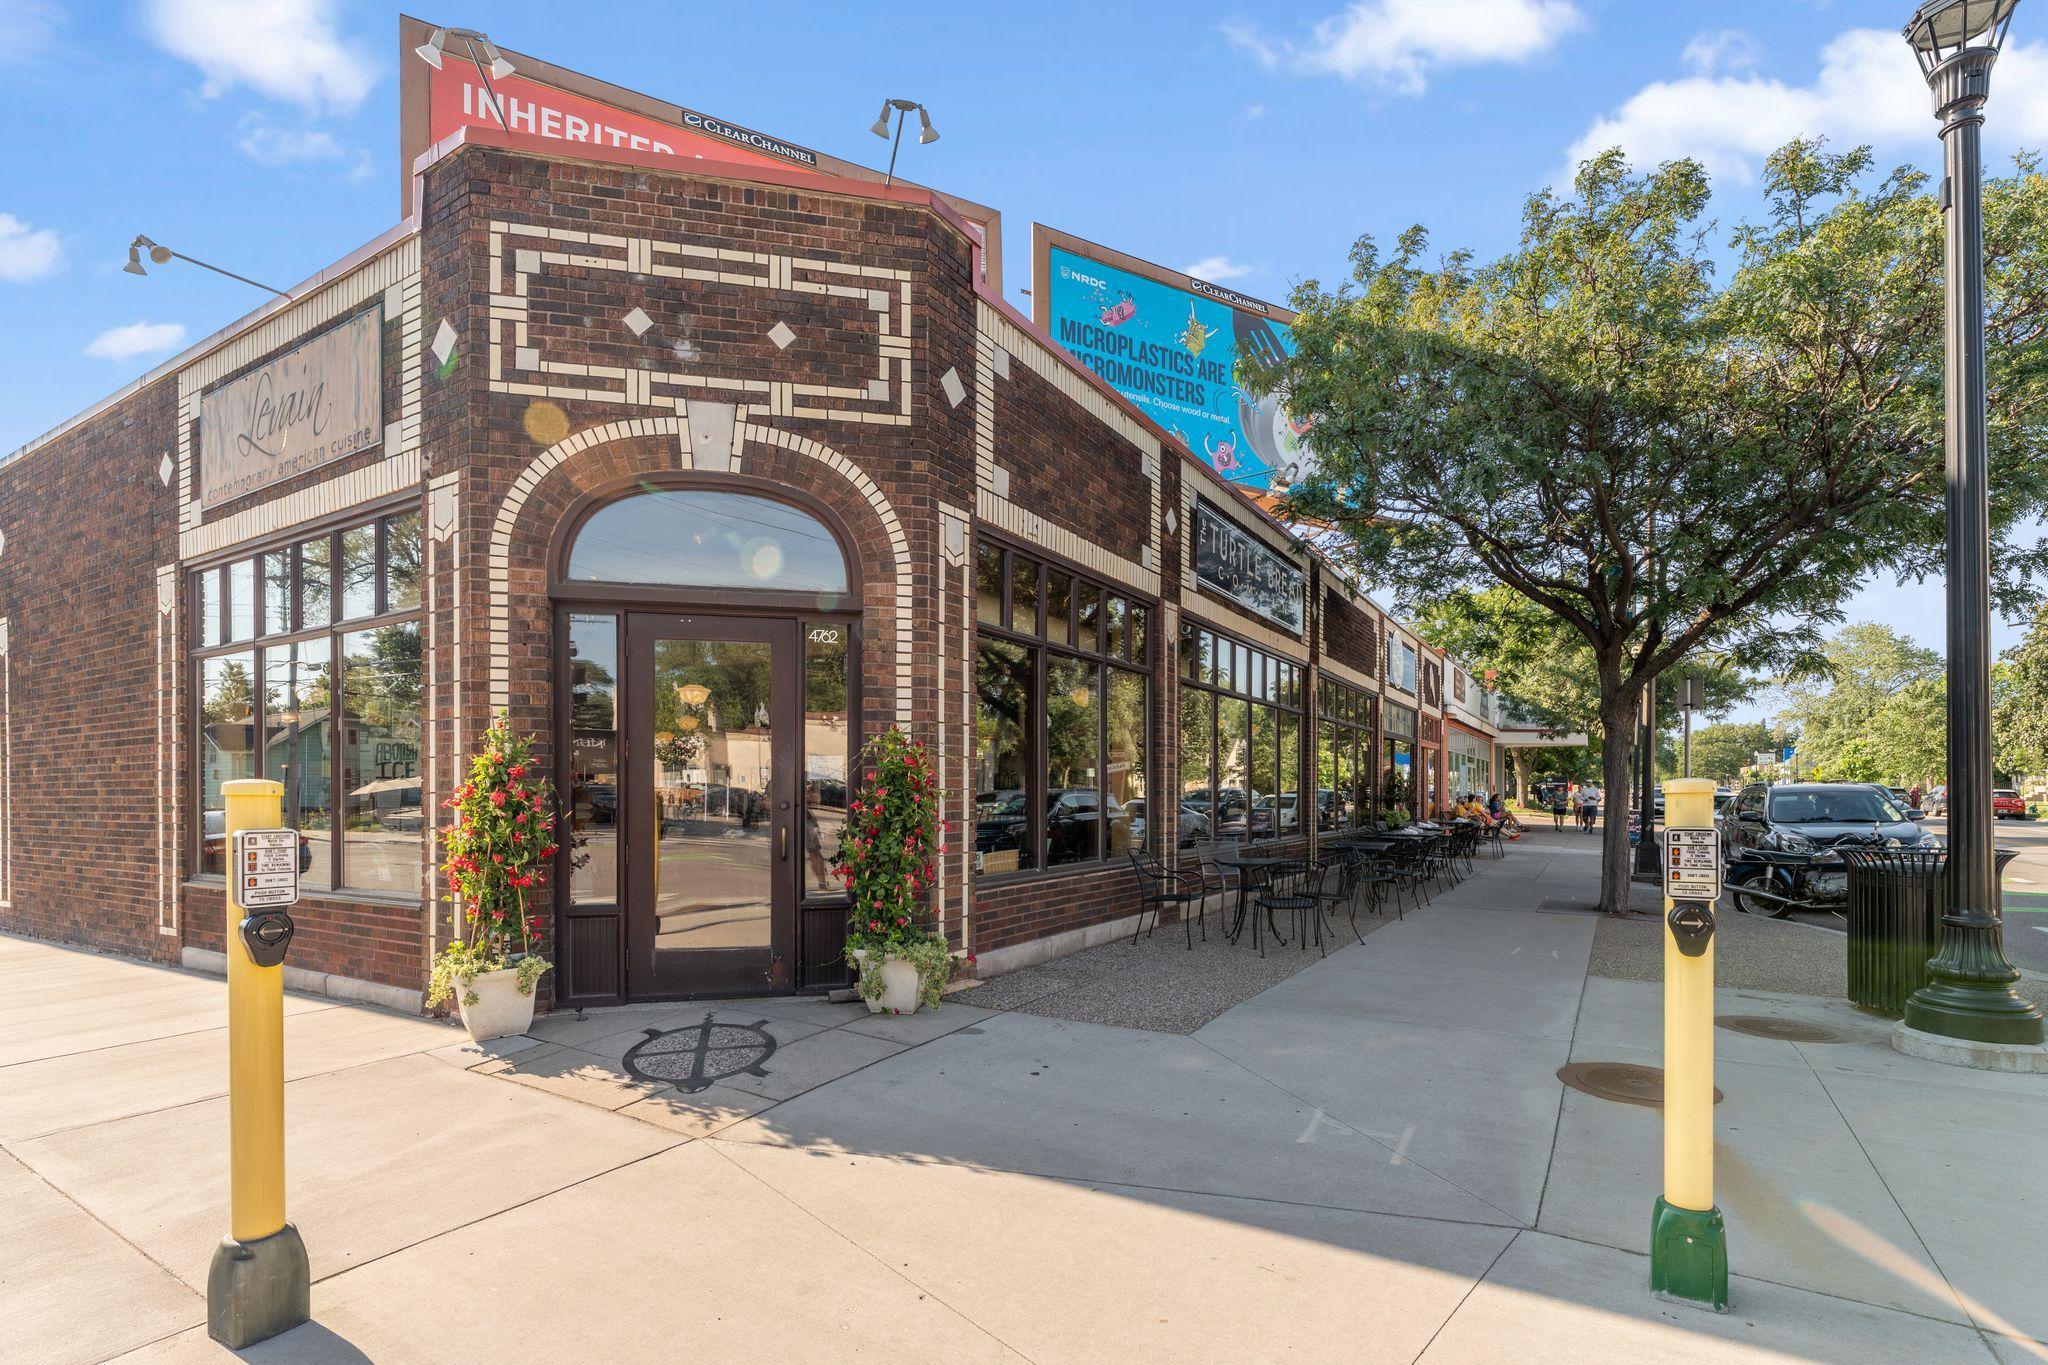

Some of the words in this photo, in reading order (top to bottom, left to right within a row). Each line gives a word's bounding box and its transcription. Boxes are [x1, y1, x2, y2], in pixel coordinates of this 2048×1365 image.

[1071, 270, 1107, 290] NRDC
[1060, 316, 1194, 376] MICROPLASTICS
[1197, 360, 1226, 386] ARE
[1067, 348, 1205, 406] CROMONSTERS
[237, 363, 332, 457] Levain
[1153, 398, 1181, 412] Choose
[1182, 406, 1201, 417] wood
[1211, 414, 1232, 424] metal.
[207, 466, 273, 501] contemporary
[278, 446, 325, 474] american
[331, 425, 371, 453] cuisine
[1210, 522, 1262, 582] TURTLE
[1267, 561, 1303, 605] BREAD
[809, 629, 838, 643] 4762
